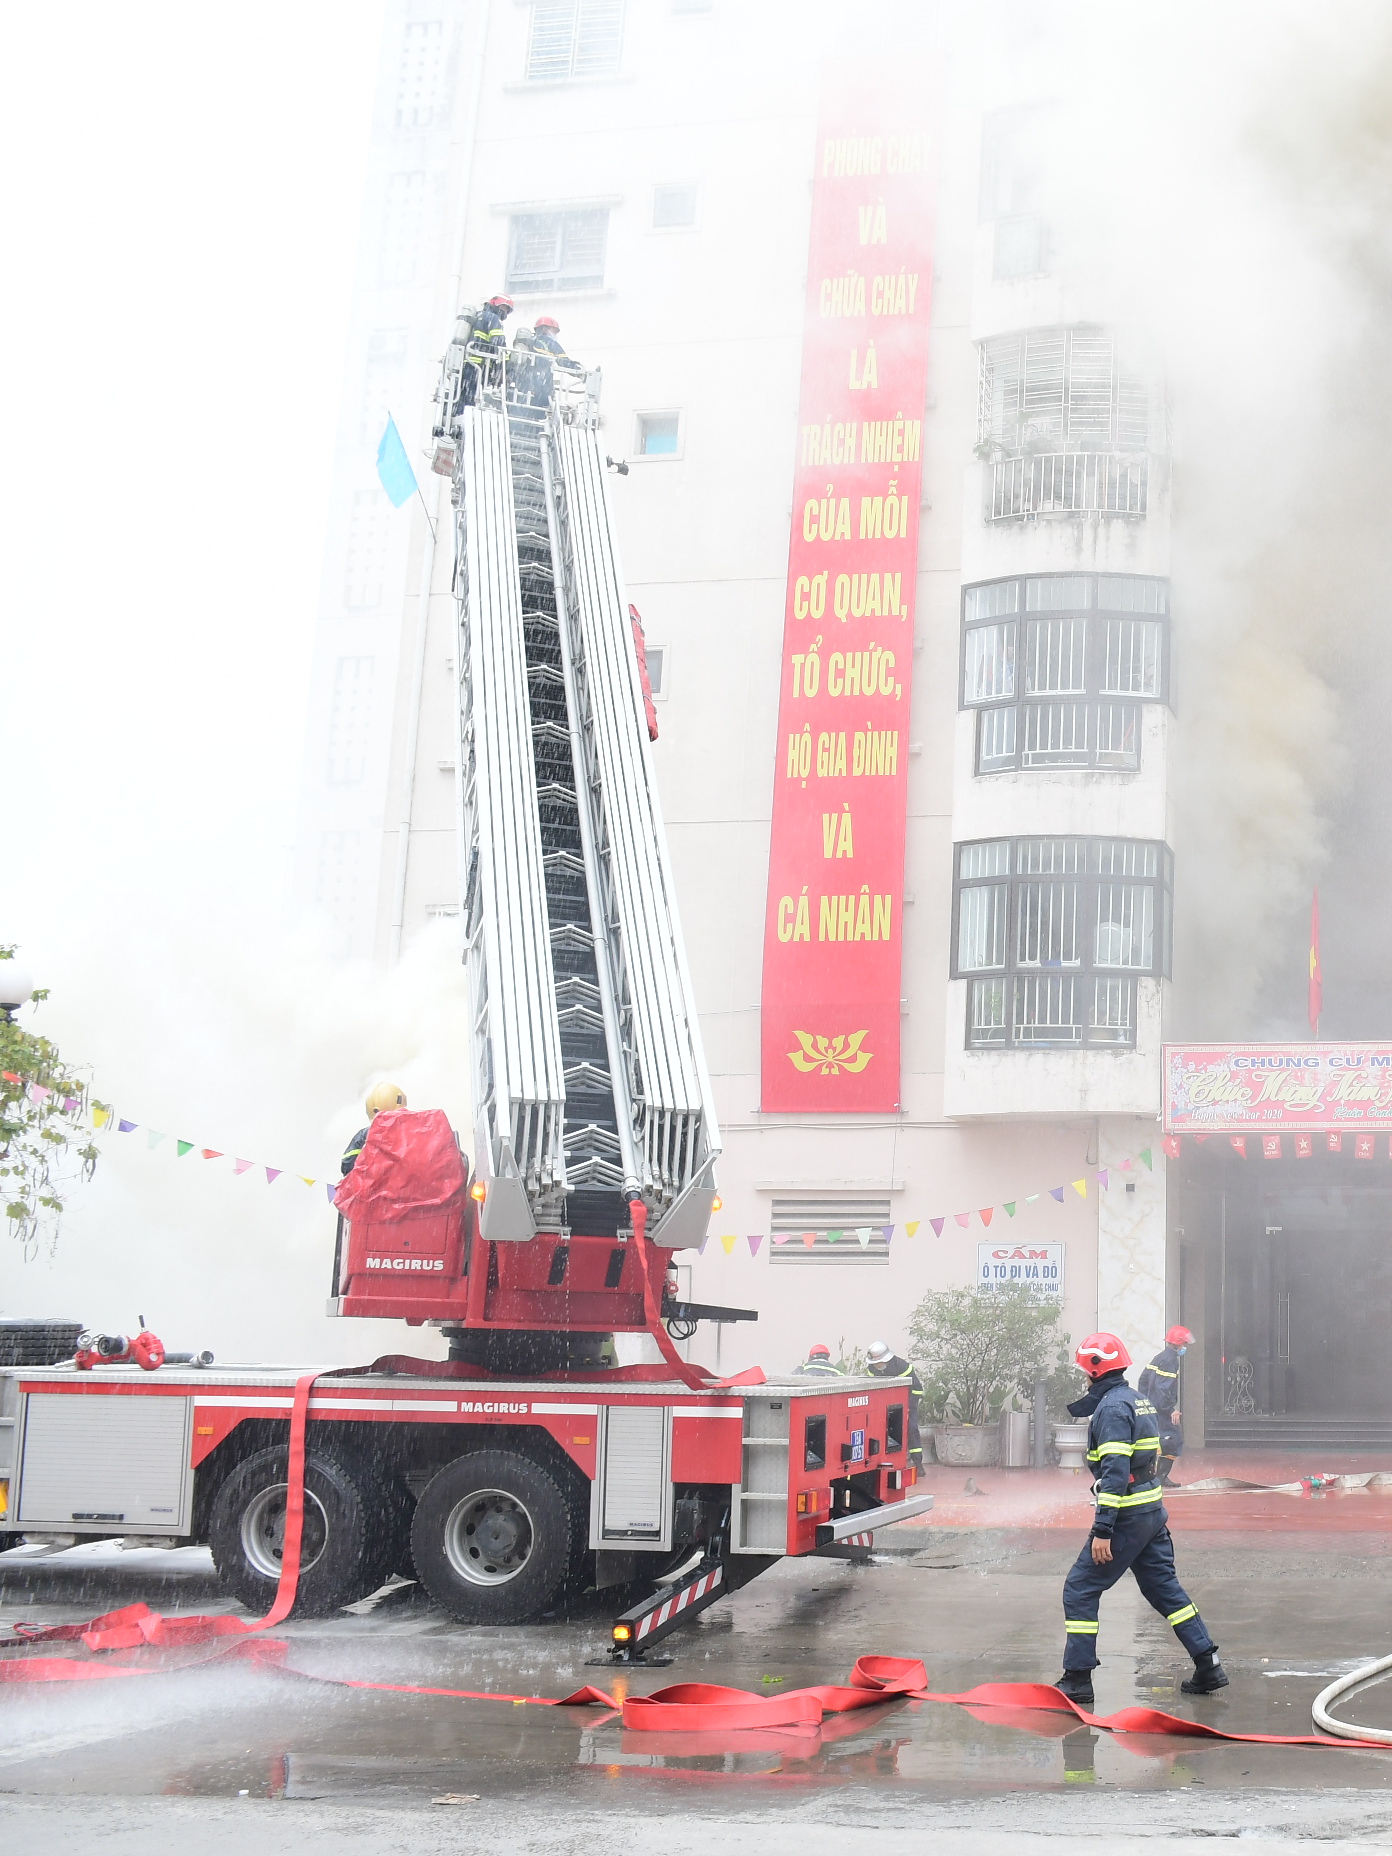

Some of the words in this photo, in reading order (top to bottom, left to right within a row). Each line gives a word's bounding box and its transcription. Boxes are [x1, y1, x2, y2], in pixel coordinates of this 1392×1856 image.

[823, 129, 881, 177] PHÒNG
[858, 197, 887, 245] VÀ
[820, 269, 866, 319] CHỮA
[871, 266, 919, 315] CHÁY
[849, 340, 878, 389] LÀ
[802, 413, 856, 467] TRÁCH
[861, 411, 920, 472] NHIỆM
[802, 484, 851, 542] CỦA
[860, 479, 908, 538] MỖI
[794, 572, 827, 621] CƠ
[834, 572, 907, 623] QUAN,
[792, 635, 823, 698] TỔ
[828, 640, 901, 700] CHỨC,
[787, 723, 812, 788] HỘ
[817, 732, 847, 777] GIA
[853, 722, 898, 776] ĐÌNH
[822, 803, 853, 859] VÀ
[778, 883, 810, 942] CÁ
[819, 885, 891, 941] NHÂN
[1233, 1056, 1320, 1068] CHUNG
[1328, 1055, 1364, 1067] CƯ
[1182, 1070, 1253, 1107] Chúc
[1244, 1070, 1326, 1113] Mừng
[1326, 1070, 1381, 1102] Năm
[1191, 1109, 1218, 1122] Happy
[1261, 1109, 1283, 1120] 2020
[366, 1256, 444, 1271] MAGIRUS
[982, 1262, 990, 1279] Ô
[993, 1262, 1007, 1279] TÔ
[1009, 1265, 1021, 1279] ĐI
[1025, 1262, 1039, 1279] VÀ
[1042, 1260, 1058, 1279] ĐỖ
[991, 1245, 1049, 1260] CẤM
[461, 1401, 528, 1414] MAGIRUS
